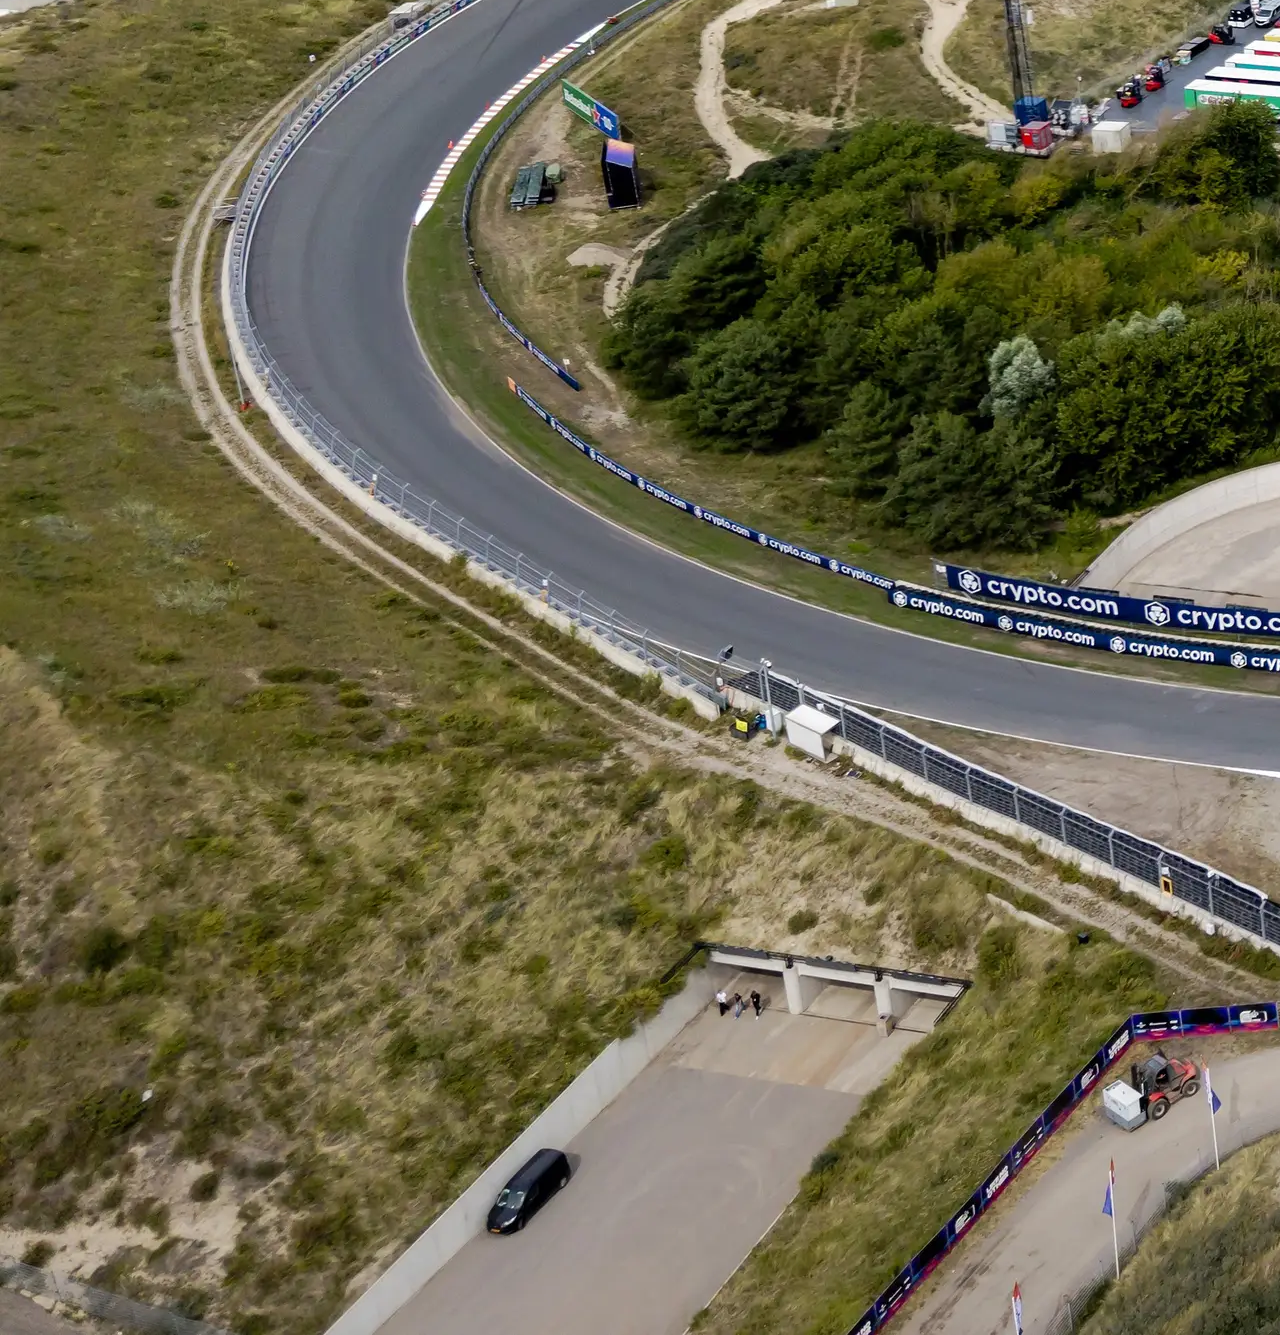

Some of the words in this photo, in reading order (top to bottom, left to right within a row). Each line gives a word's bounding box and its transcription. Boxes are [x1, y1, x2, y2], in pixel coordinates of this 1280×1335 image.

[704, 511, 750, 538] crypto.com
[769, 538, 820, 565] crypto.com
[909, 593, 984, 624] crypto.com
[986, 577, 1119, 617] crypto.com
[1015, 618, 1095, 646] crypto.com
[1128, 638, 1215, 663] crypto.com
